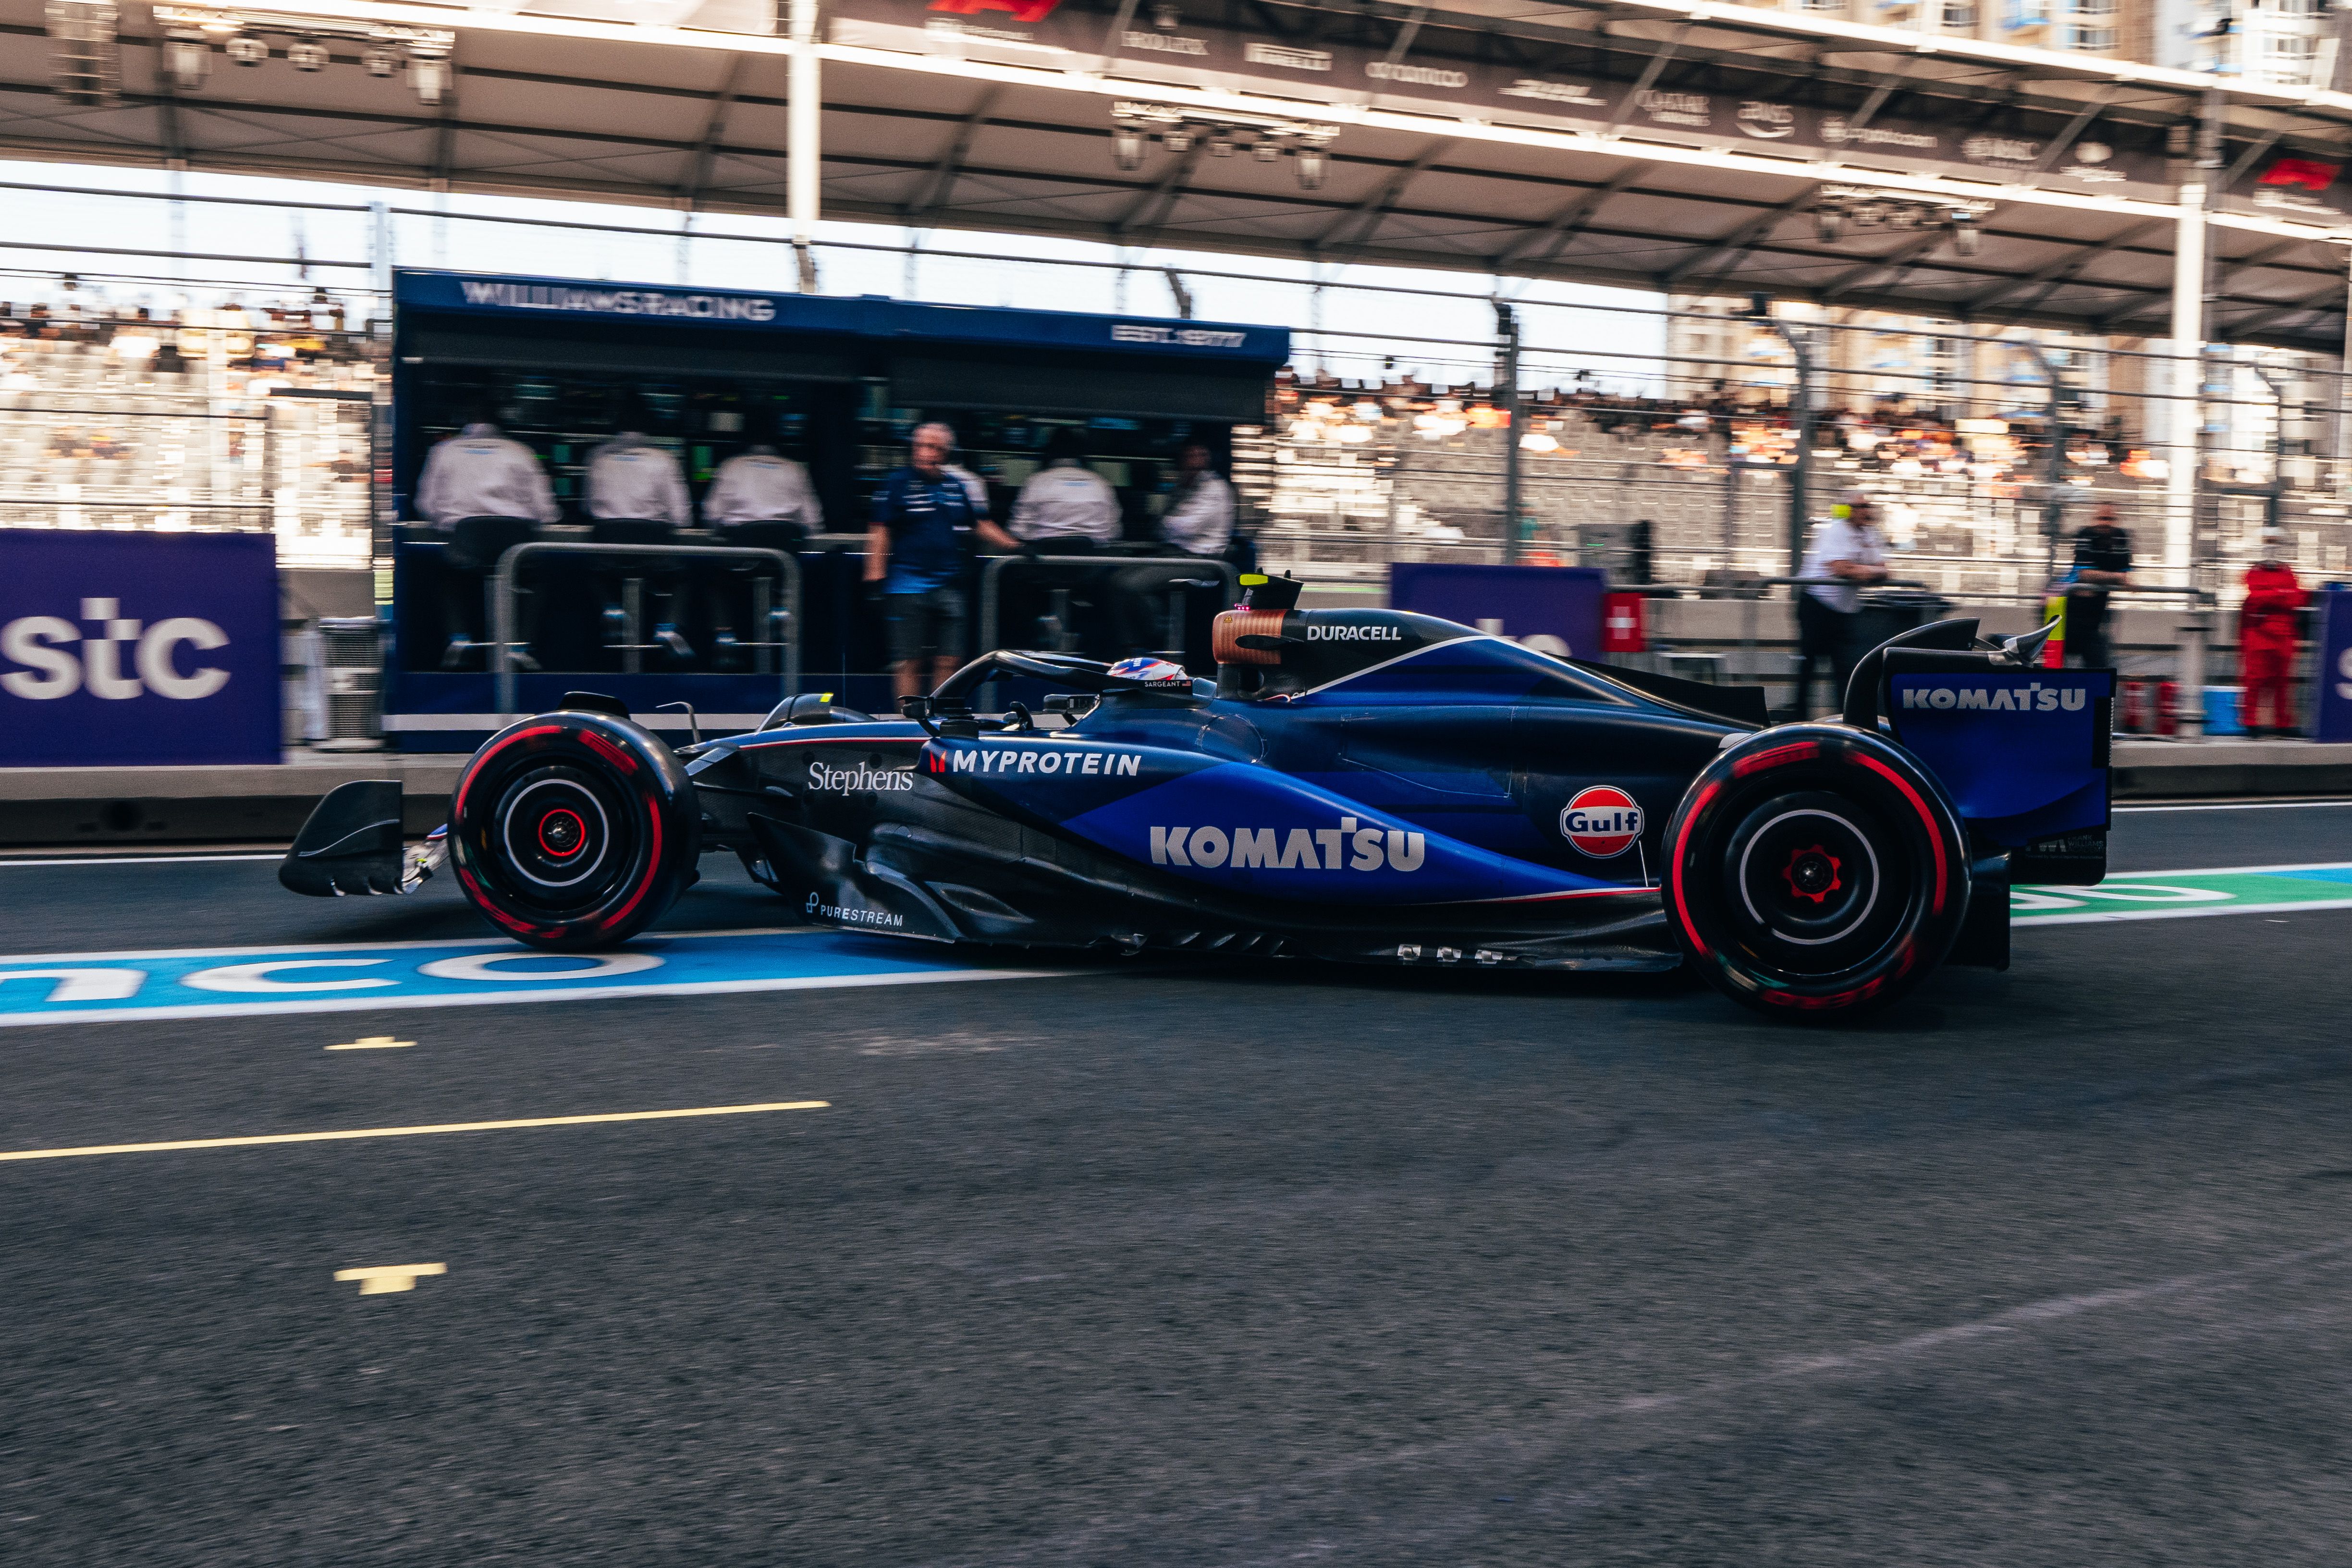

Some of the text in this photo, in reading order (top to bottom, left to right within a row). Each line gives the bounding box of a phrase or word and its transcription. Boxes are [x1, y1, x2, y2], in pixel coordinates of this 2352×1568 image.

[640, 293, 776, 321] RACING
[1307, 625, 1402, 641] DURACELL
[0, 598, 230, 700] stc
[1903, 683, 2085, 711] KOMATSU
[953, 750, 1141, 776] MYPROTEIN
[808, 762, 913, 796] Stephens
[1566, 812, 1638, 833] Gulf
[1150, 817, 1425, 872] KOMATSU
[821, 905, 904, 927] PURESTREAM
